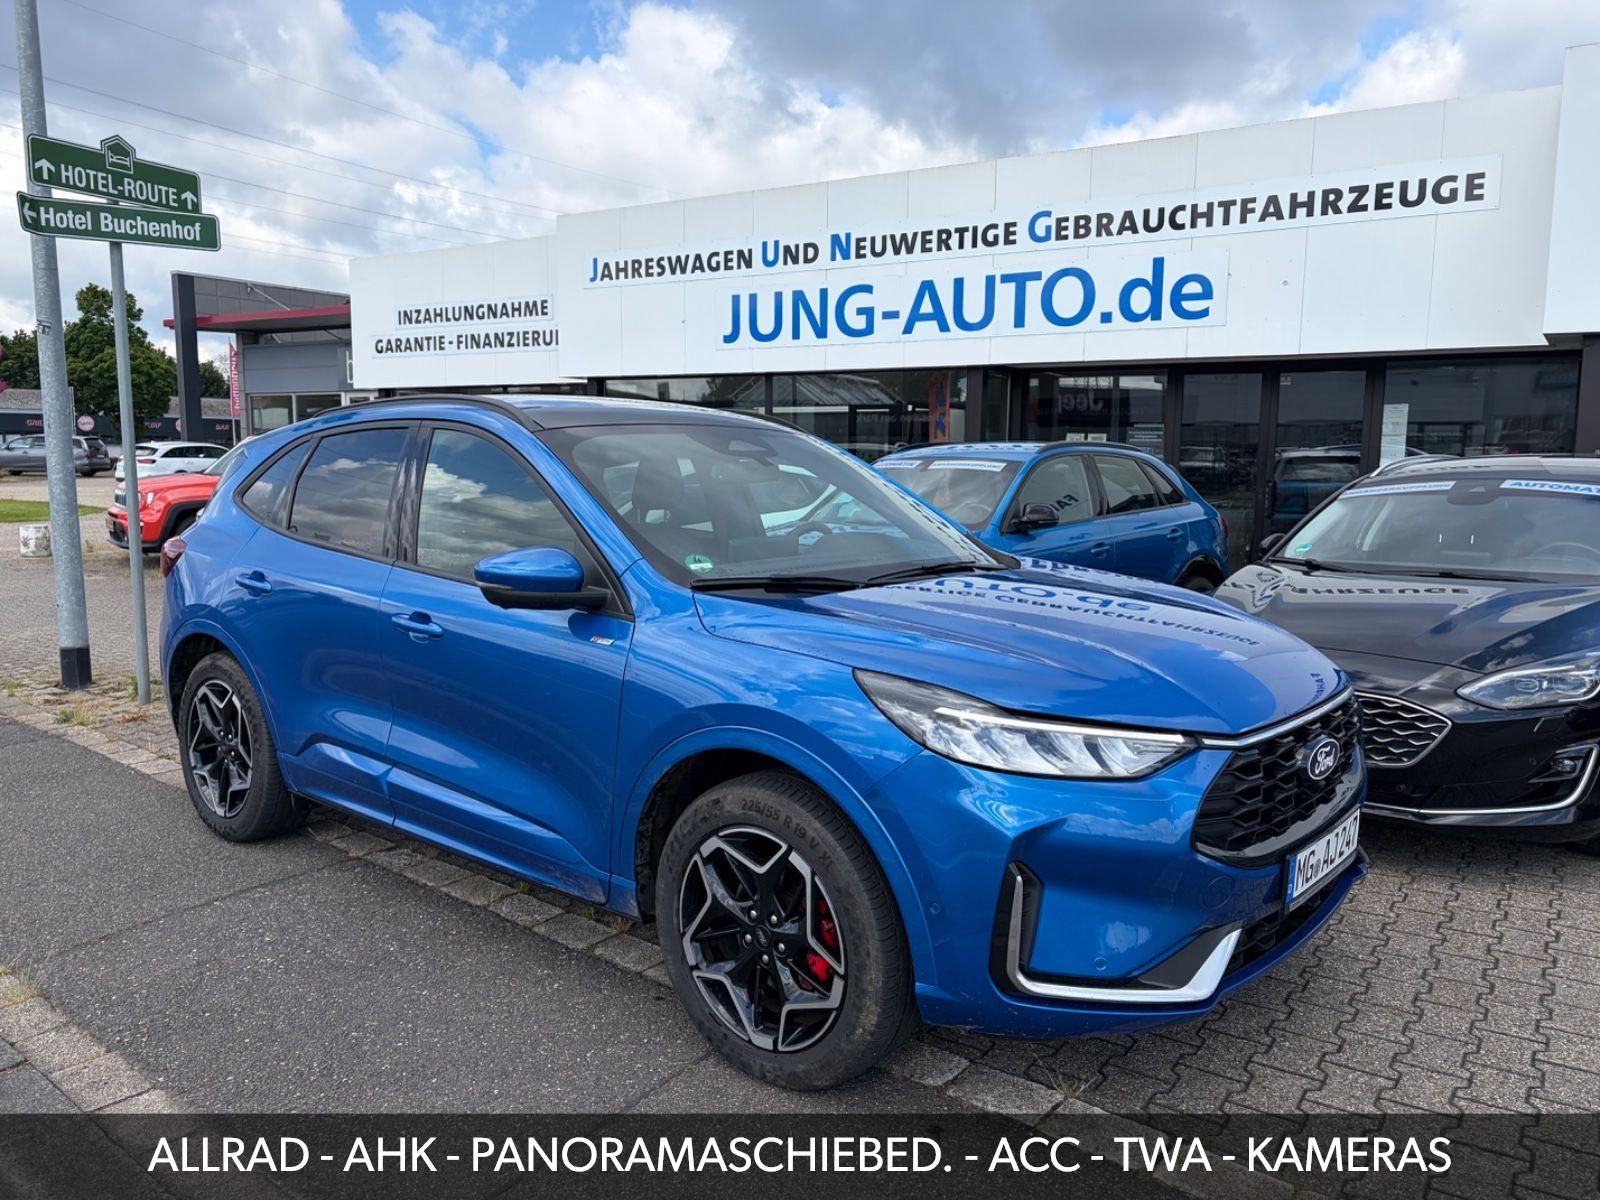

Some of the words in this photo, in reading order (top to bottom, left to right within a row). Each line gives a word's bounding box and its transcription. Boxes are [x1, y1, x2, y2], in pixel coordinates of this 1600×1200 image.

[60, 163, 179, 207] HOTEL-ROUTE
[40, 207, 93, 231] Hotel
[100, 212, 201, 241] Buchenhof
[589, 248, 753, 283] JAHRESWAGEN
[761, 239, 820, 268] UND
[830, 221, 1018, 262] NEUWERTIGE
[1028, 172, 1487, 243] GEBRAUCHTFAHRZEUGE
[397, 298, 549, 326] INZAHLUNGNAHME
[722, 257, 1214, 344] JUNG-AUTO.de
[1314, 745, 1336, 774] Ford
[740, 798, 781, 821] 225/55
[1295, 850, 1316, 892] MG
[1320, 817, 1358, 873] AJ247
